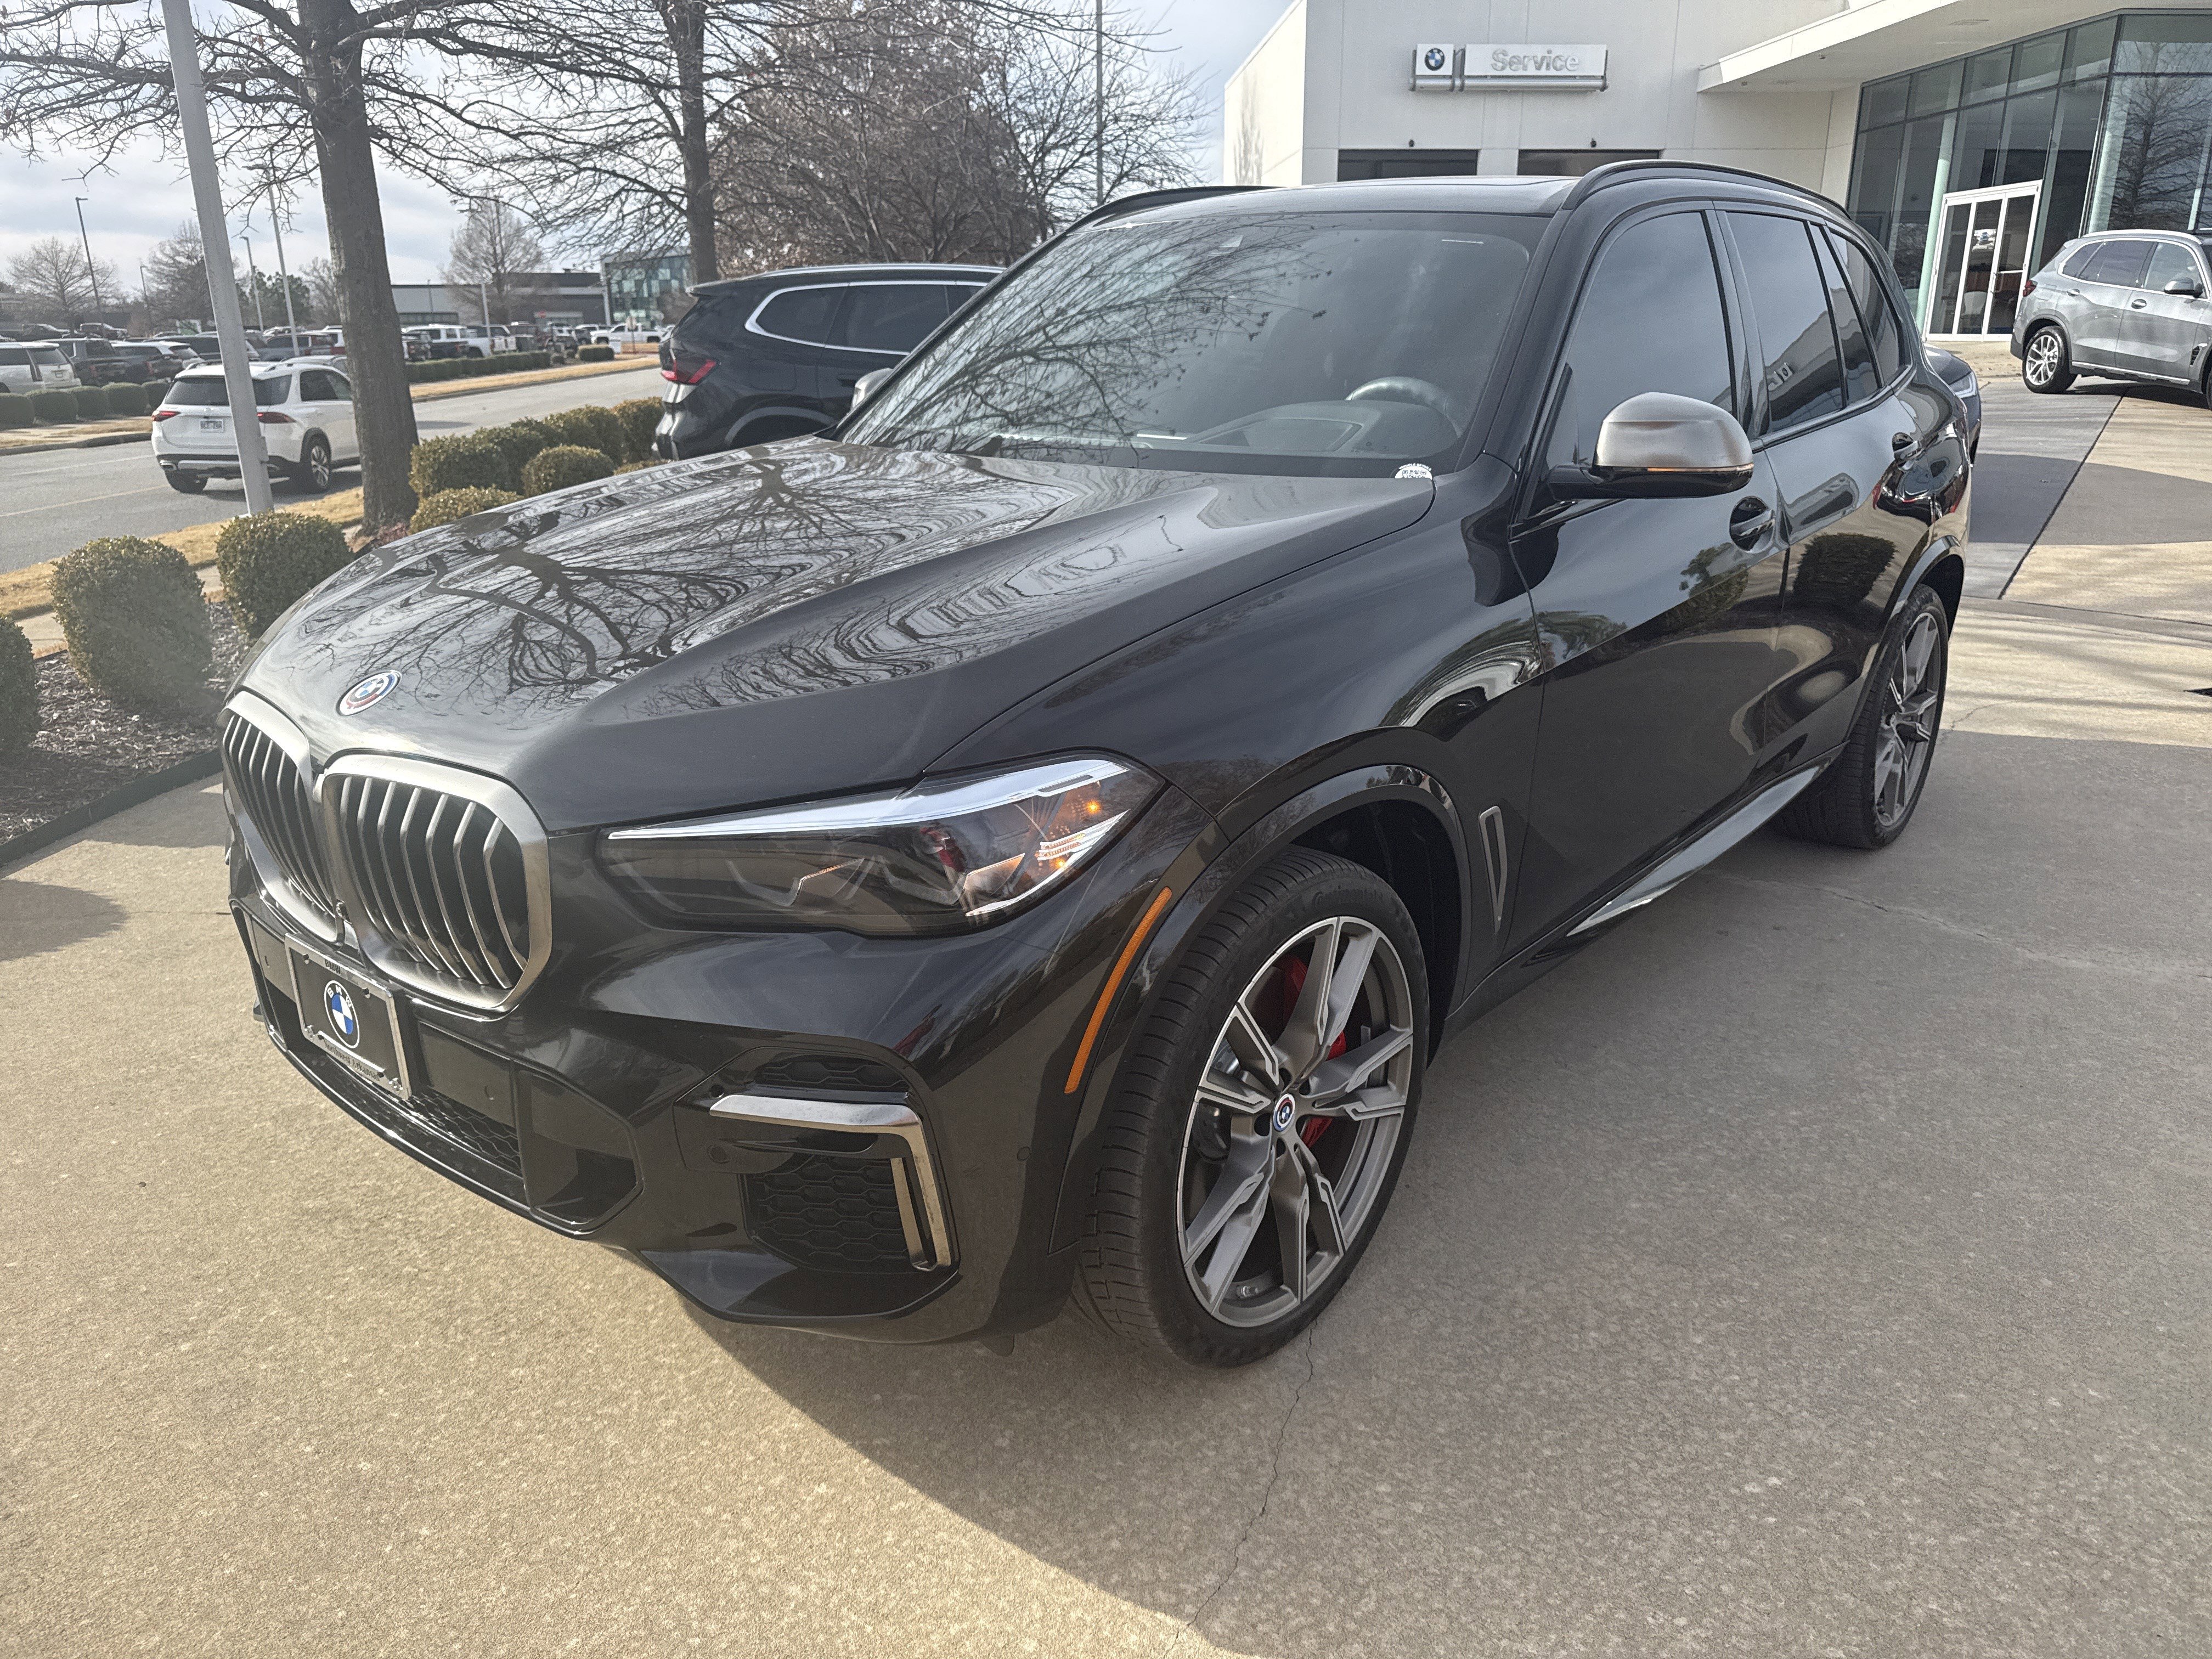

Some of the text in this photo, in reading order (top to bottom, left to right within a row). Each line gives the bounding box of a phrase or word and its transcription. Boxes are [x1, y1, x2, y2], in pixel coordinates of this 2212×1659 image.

[1491, 49, 1580, 71] Service
[325, 959, 341, 974] BMW
[327, 985, 352, 1008] BMW
